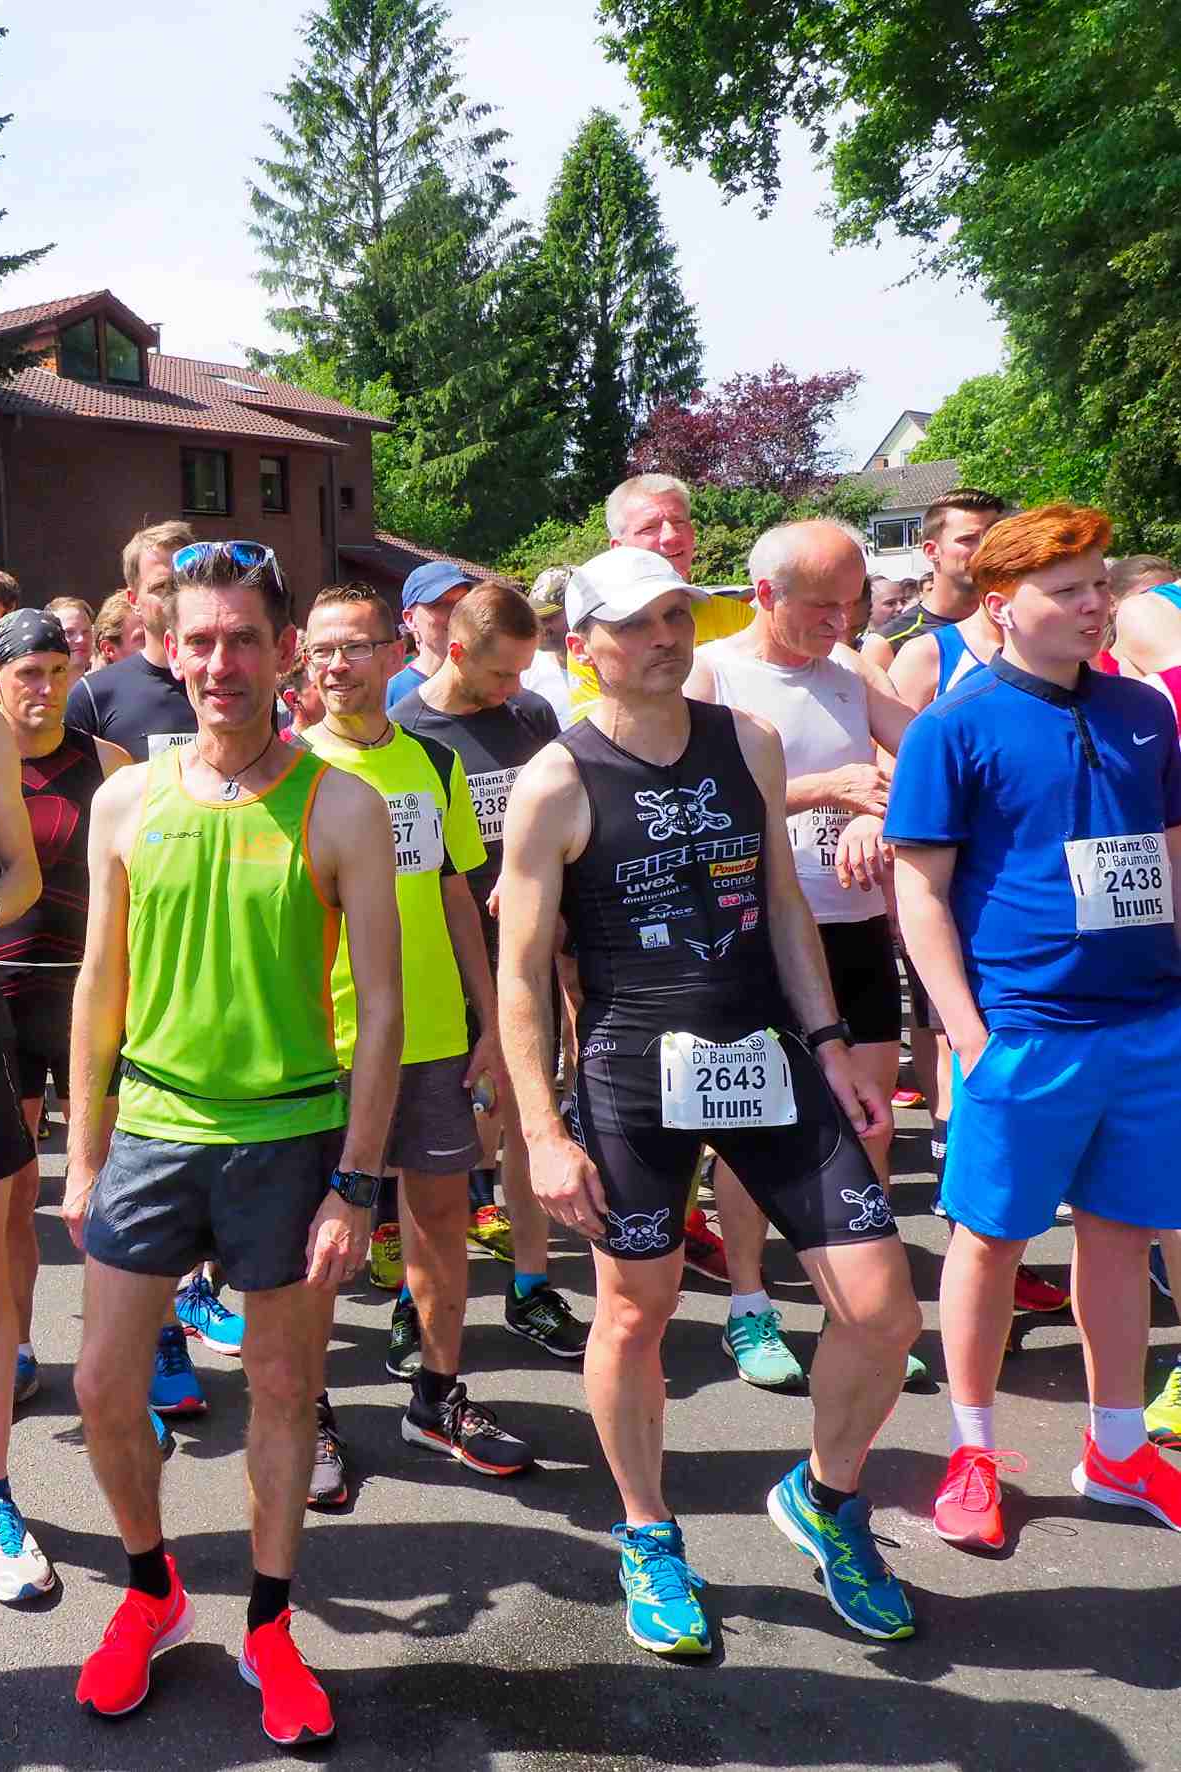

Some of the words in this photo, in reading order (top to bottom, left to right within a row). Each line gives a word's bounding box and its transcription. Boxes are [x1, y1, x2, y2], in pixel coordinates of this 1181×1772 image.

[169, 736, 192, 746] Alli
[468, 775, 504, 788] Allianz
[480, 784, 513, 798] Bauma
[473, 796, 507, 817] 238
[391, 811, 421, 821] mann
[393, 823, 413, 844] 57
[478, 819, 503, 836] bru
[816, 828, 839, 846] 23
[1096, 841, 1141, 855] Allianz
[616, 833, 760, 883] PIRATE
[1098, 857, 1111, 868] D.
[1112, 854, 1161, 867] Baumann
[627, 873, 675, 894] uvex
[1104, 867, 1162, 893] 2438
[1112, 896, 1163, 918] bruns
[693, 1052, 705, 1065] D.
[709, 1051, 766, 1064] Baumann
[696, 1065, 766, 1092] 2643
[703, 1095, 762, 1119] bruns
